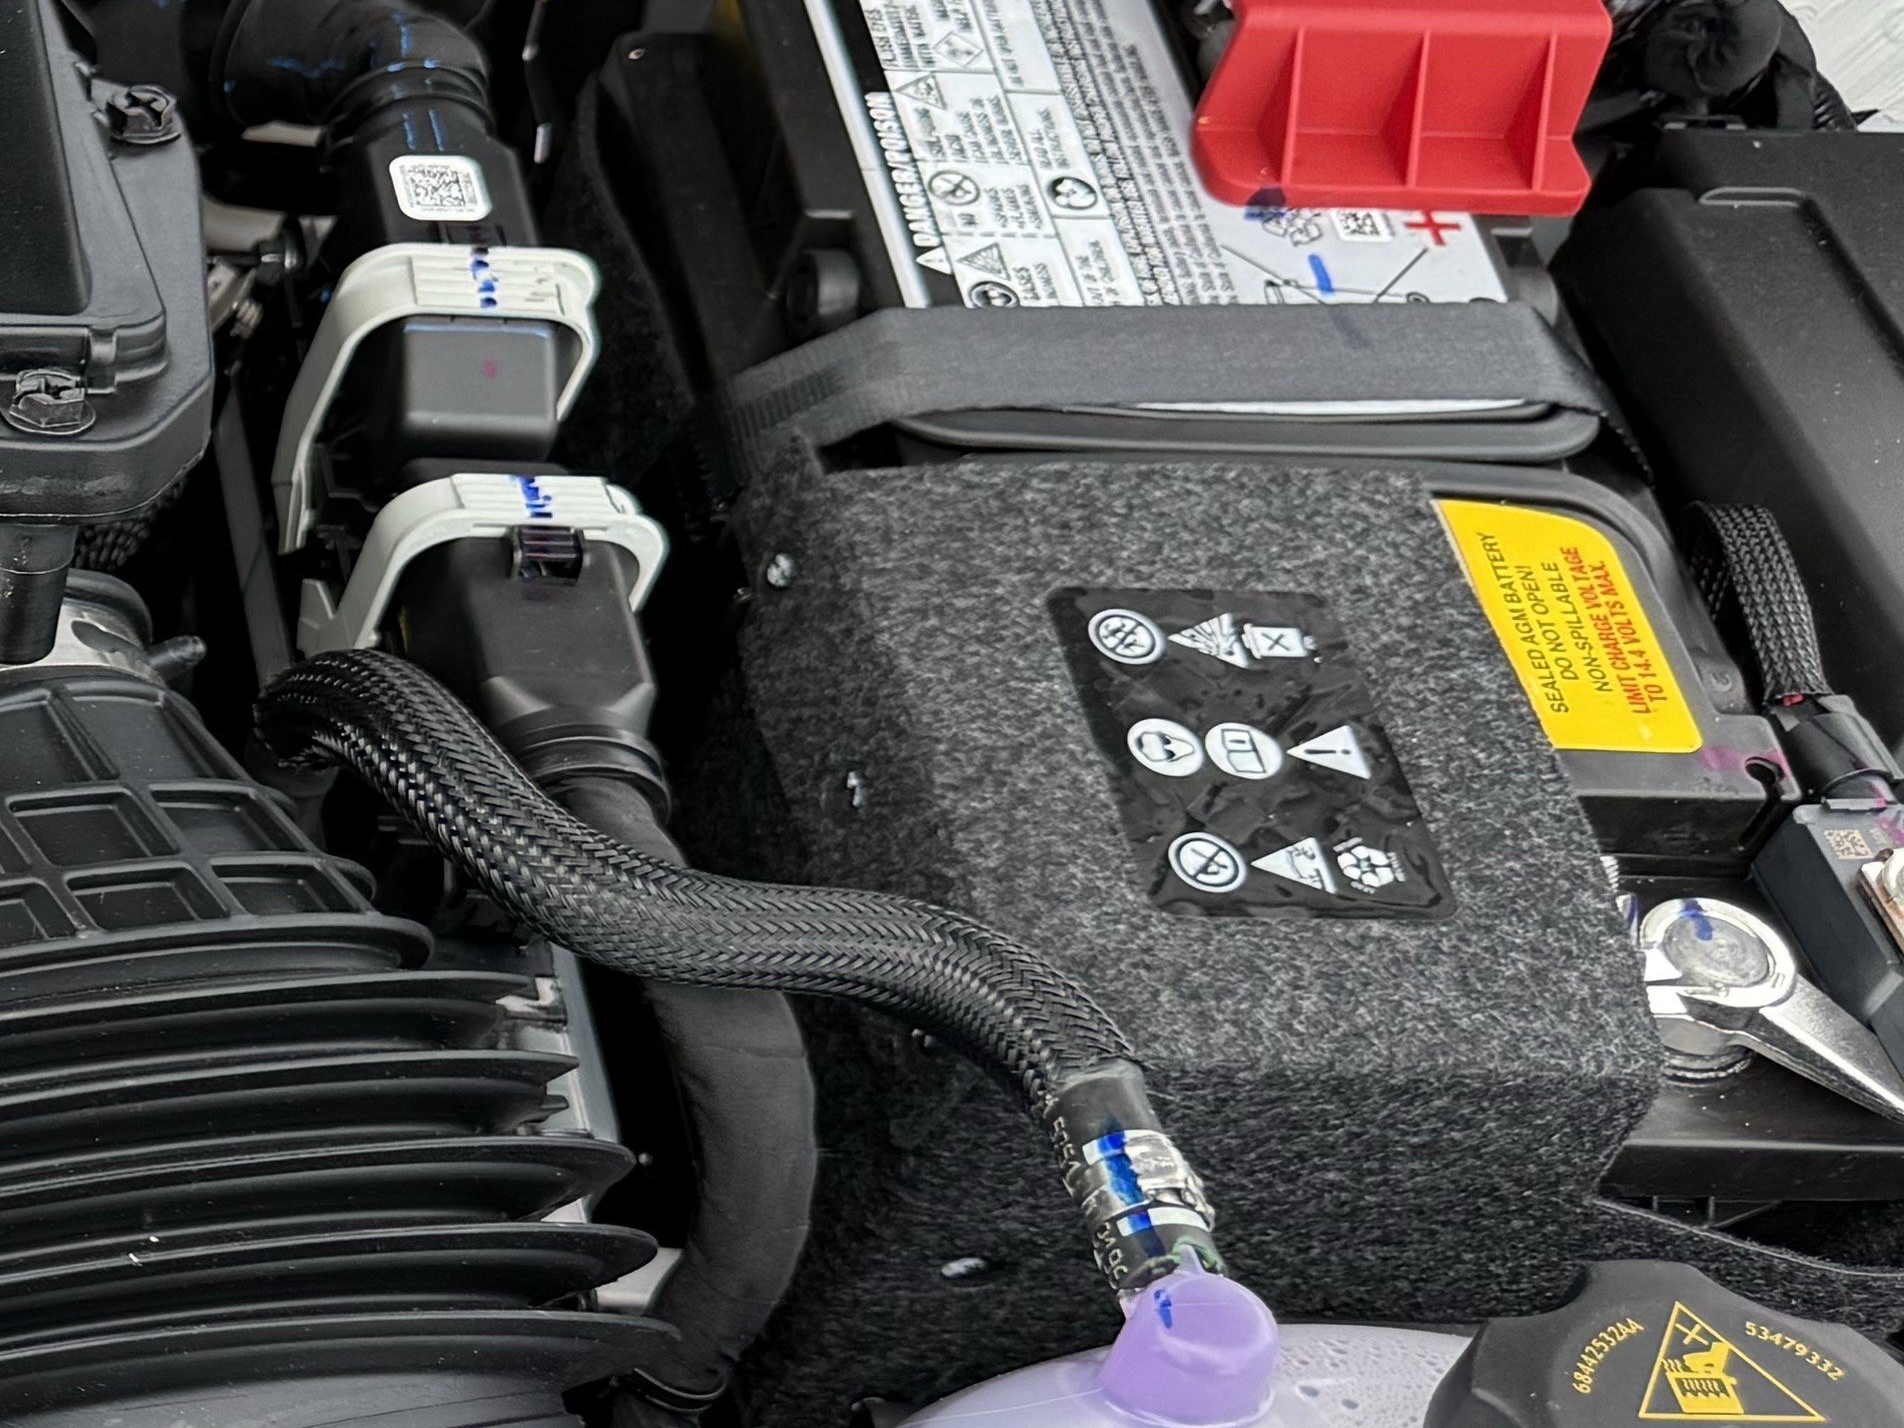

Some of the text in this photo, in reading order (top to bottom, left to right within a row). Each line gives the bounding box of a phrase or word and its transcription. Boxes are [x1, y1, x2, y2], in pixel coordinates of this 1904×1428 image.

[1476, 532, 1570, 713] SEALED AGM BATTERY
[1514, 565, 1580, 681] DO NOT OPEN!
[1540, 561, 1614, 693] NON-SPILLABLE
[1559, 546, 1652, 714] LIMIT CHARGE VOLTAGE
[1588, 560, 1668, 703] TO 14.4 VOLTS MAX.
[1572, 1317, 1645, 1394] 68442532AA
[1744, 1320, 1847, 1382] 53479332
